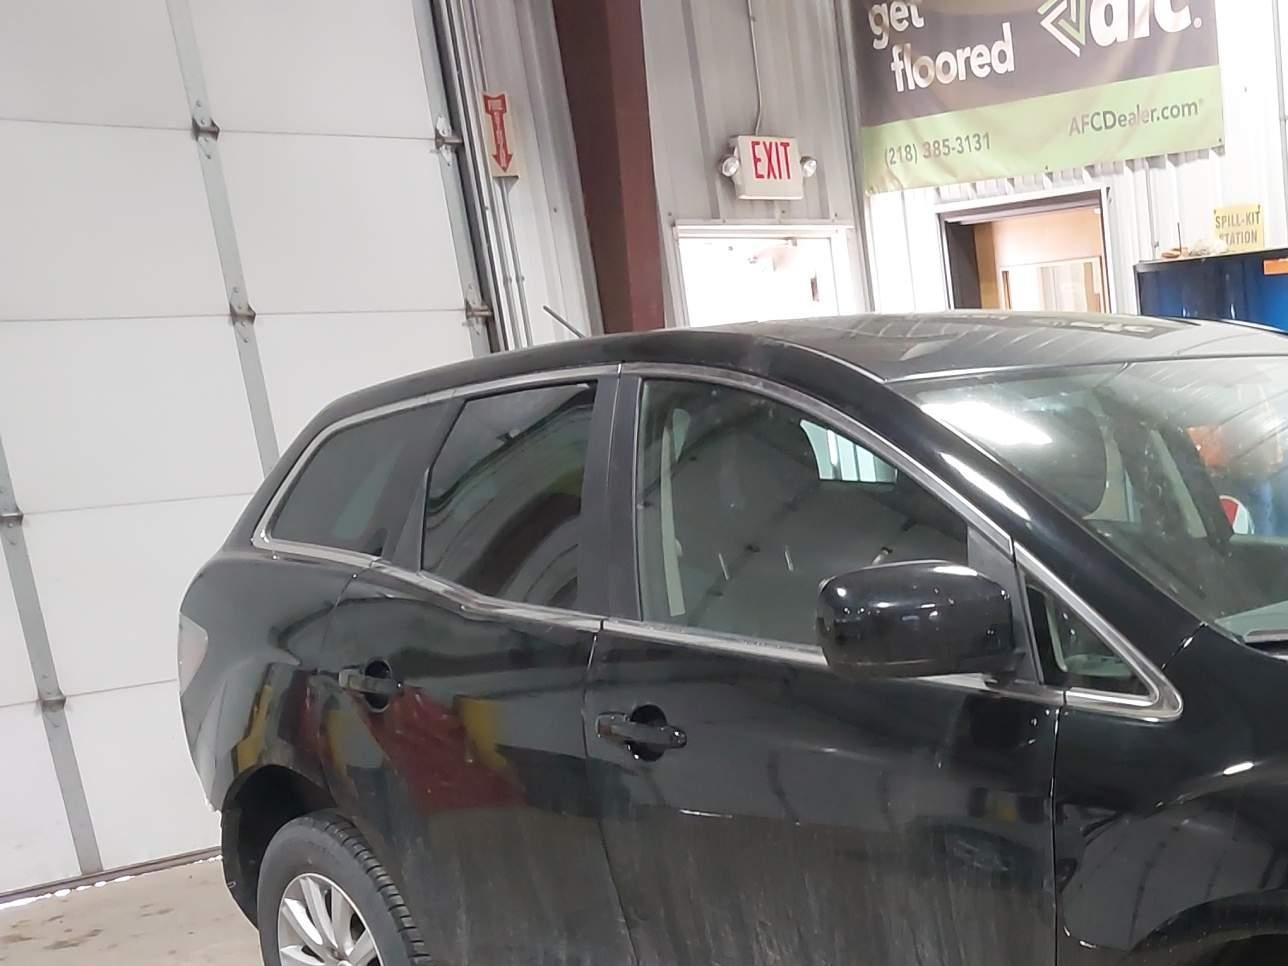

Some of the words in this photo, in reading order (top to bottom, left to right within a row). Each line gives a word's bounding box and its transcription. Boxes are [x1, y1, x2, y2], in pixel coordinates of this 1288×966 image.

[891, 22, 1015, 92] floored
[1068, 101, 1200, 136] AFCDealer.com
[751, 141, 791, 180] EXIT
[884, 143, 918, 168] (218)
[922, 131, 991, 159] 385-3131
[1215, 211, 1260, 229] SPILL-KIT
